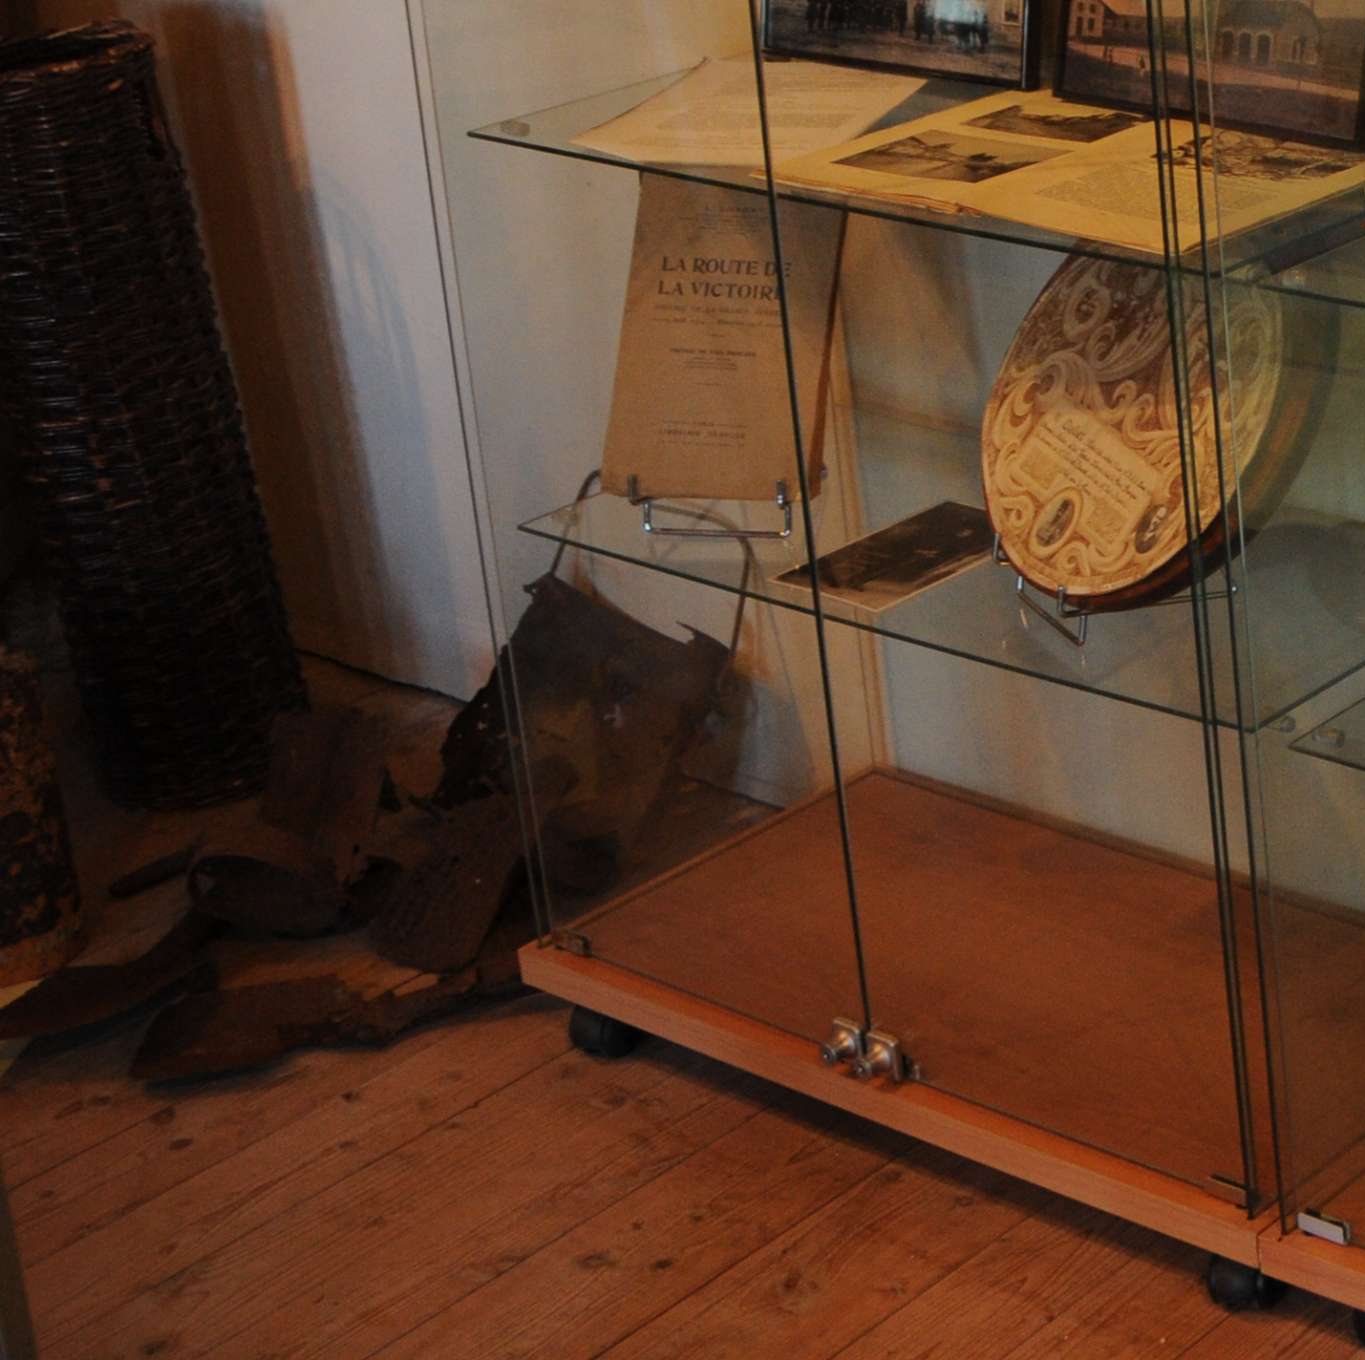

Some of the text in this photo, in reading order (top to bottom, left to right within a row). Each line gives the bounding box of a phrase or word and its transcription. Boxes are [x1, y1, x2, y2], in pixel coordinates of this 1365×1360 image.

[662, 256, 686, 272] LA
[692, 258, 758, 275] ROUTE
[657, 280, 782, 300] LA VICTOIR
